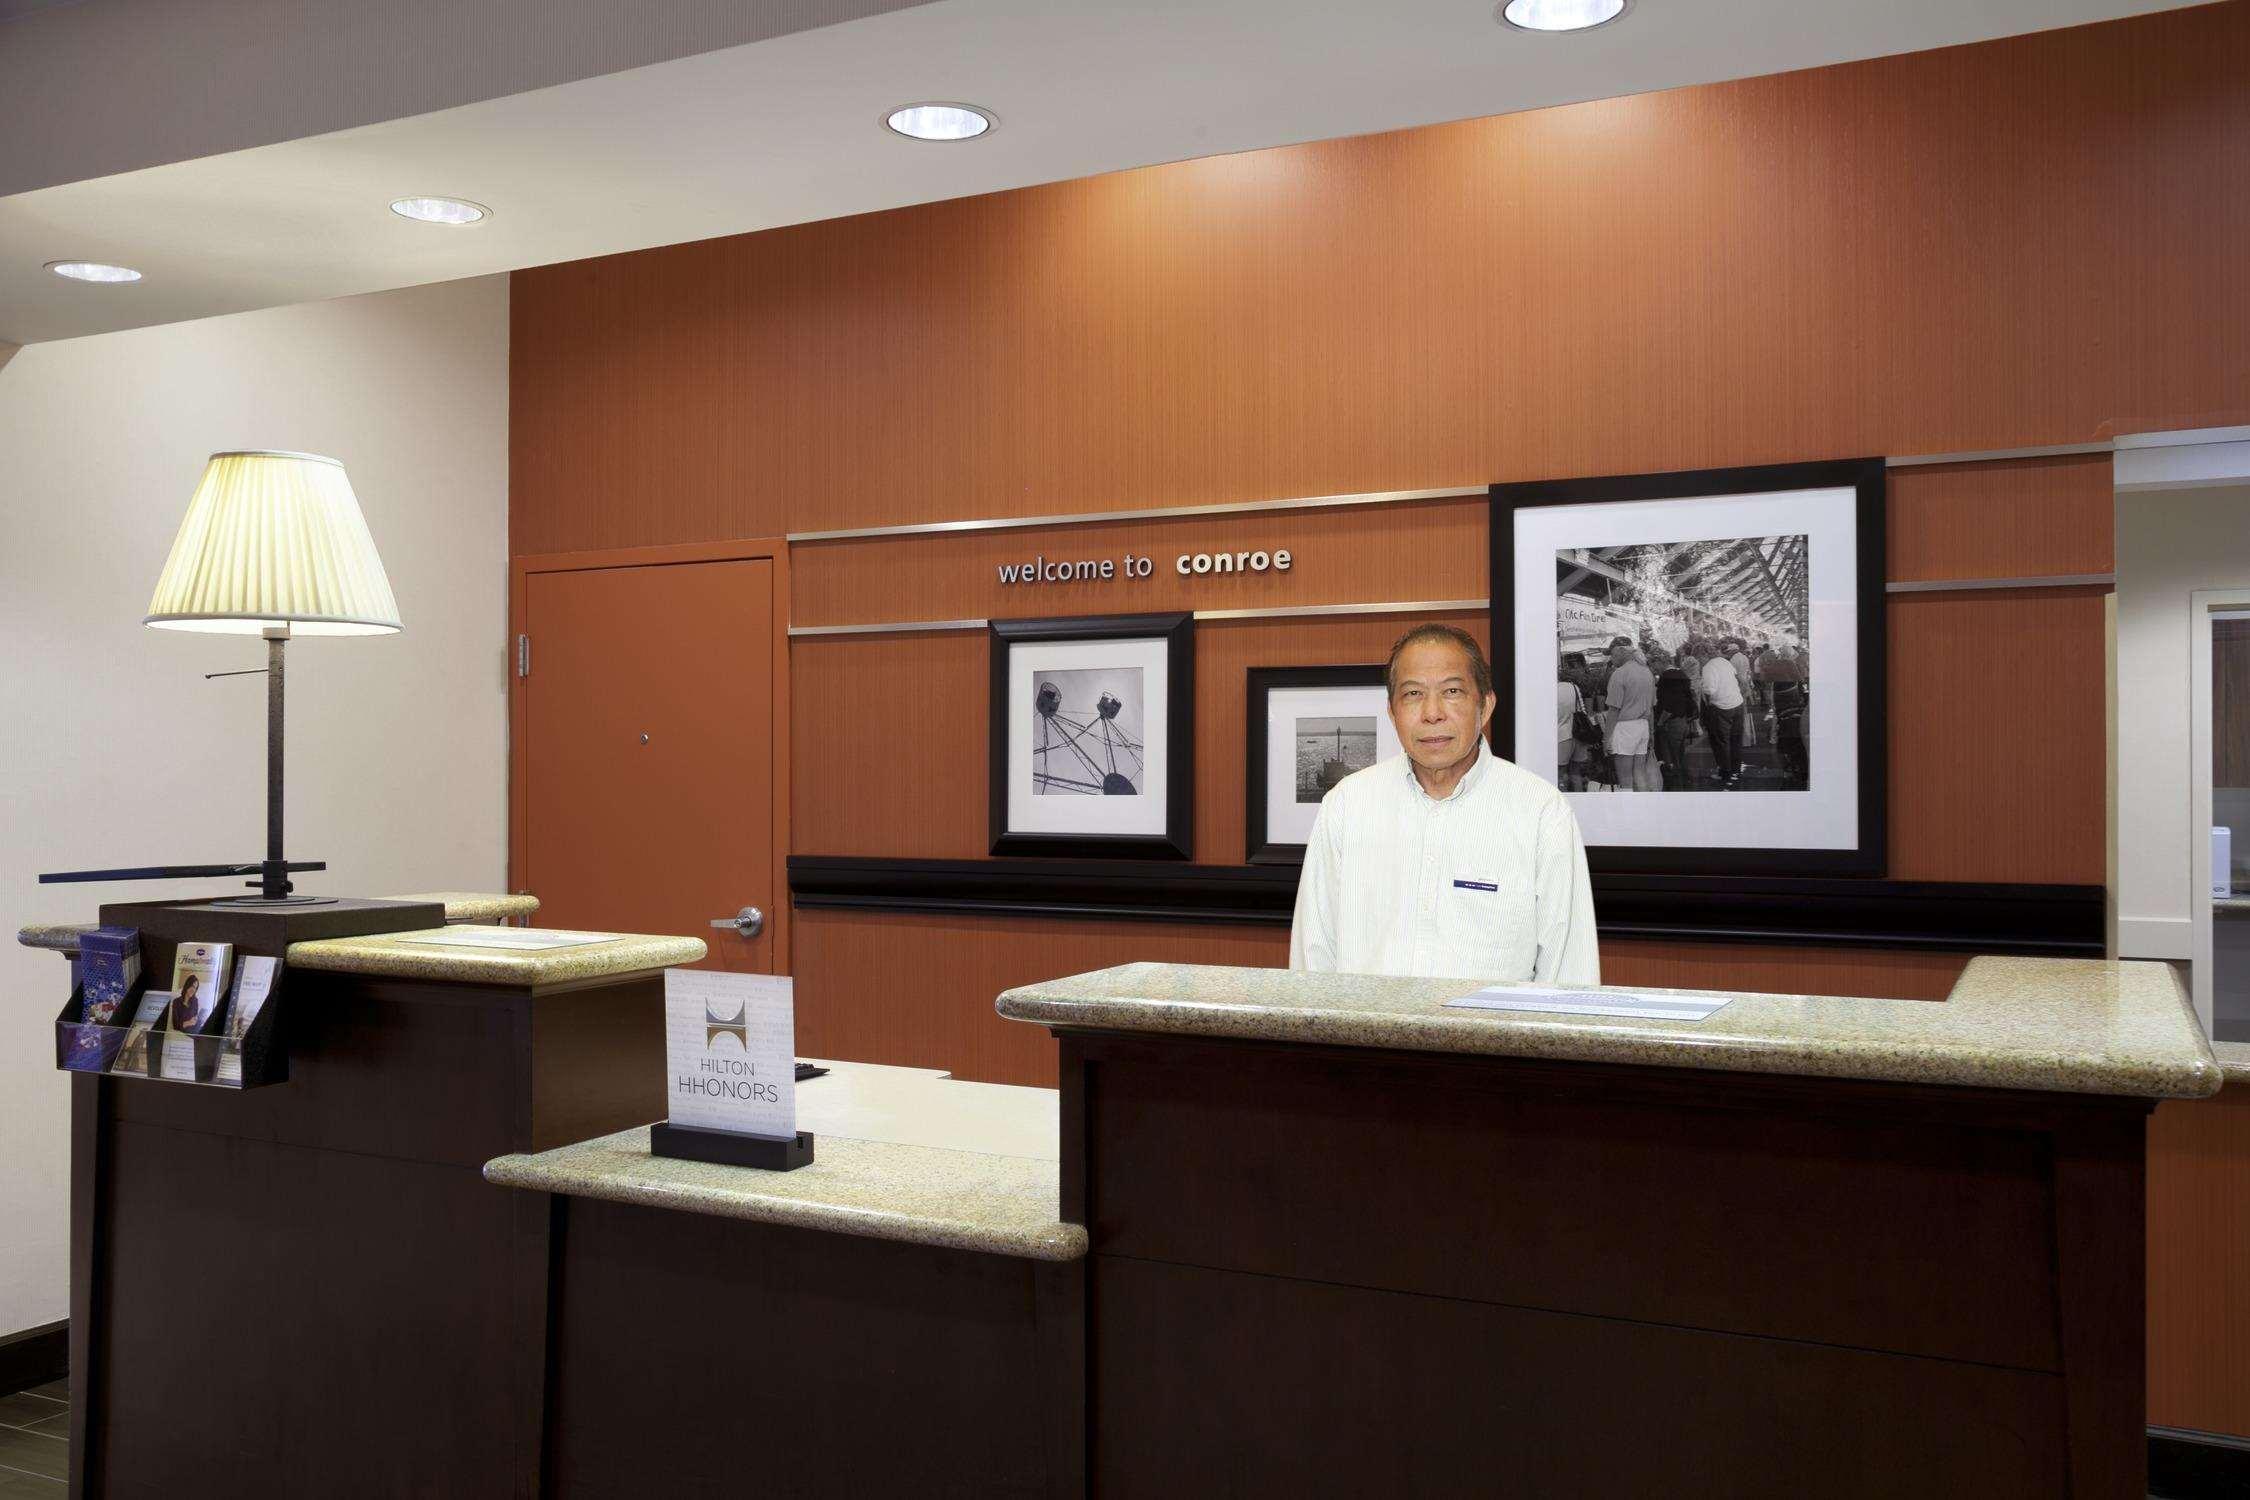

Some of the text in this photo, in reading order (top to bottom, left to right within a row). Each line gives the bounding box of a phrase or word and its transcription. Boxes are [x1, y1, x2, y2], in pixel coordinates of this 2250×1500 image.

[998, 549, 1292, 583] welcome to conroe
[700, 1058, 755, 1077] HILTON
[679, 1076, 779, 1103] HHONORS
